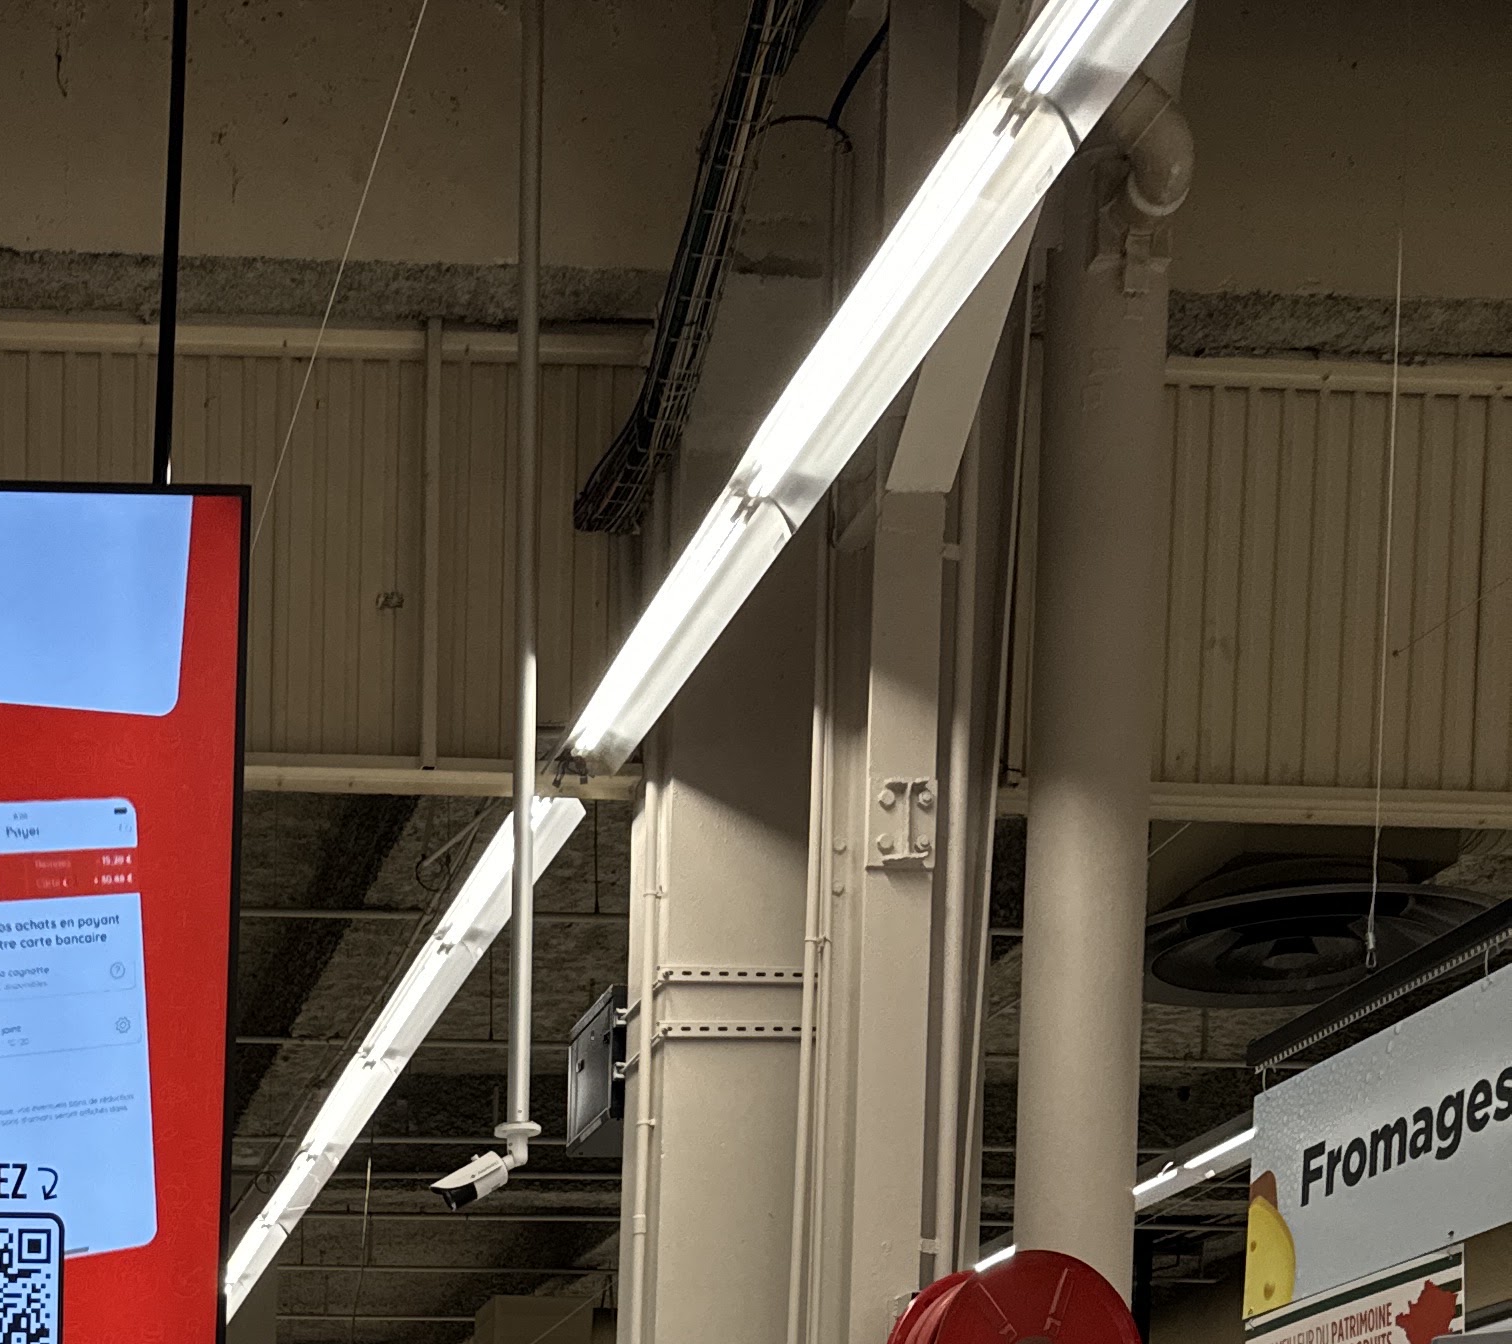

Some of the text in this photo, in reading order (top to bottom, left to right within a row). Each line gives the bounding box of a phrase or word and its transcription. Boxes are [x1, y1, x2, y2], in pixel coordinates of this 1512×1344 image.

[15, 919, 57, 932] achats
[60, 919, 74, 929] en
[77, 914, 120, 930] payant
[20, 936, 53, 948] carte
[55, 931, 107, 947] bancaire
[1301, 1066, 1512, 1208] Fromages
[1330, 1302, 1393, 1344] PATRIMOINE
